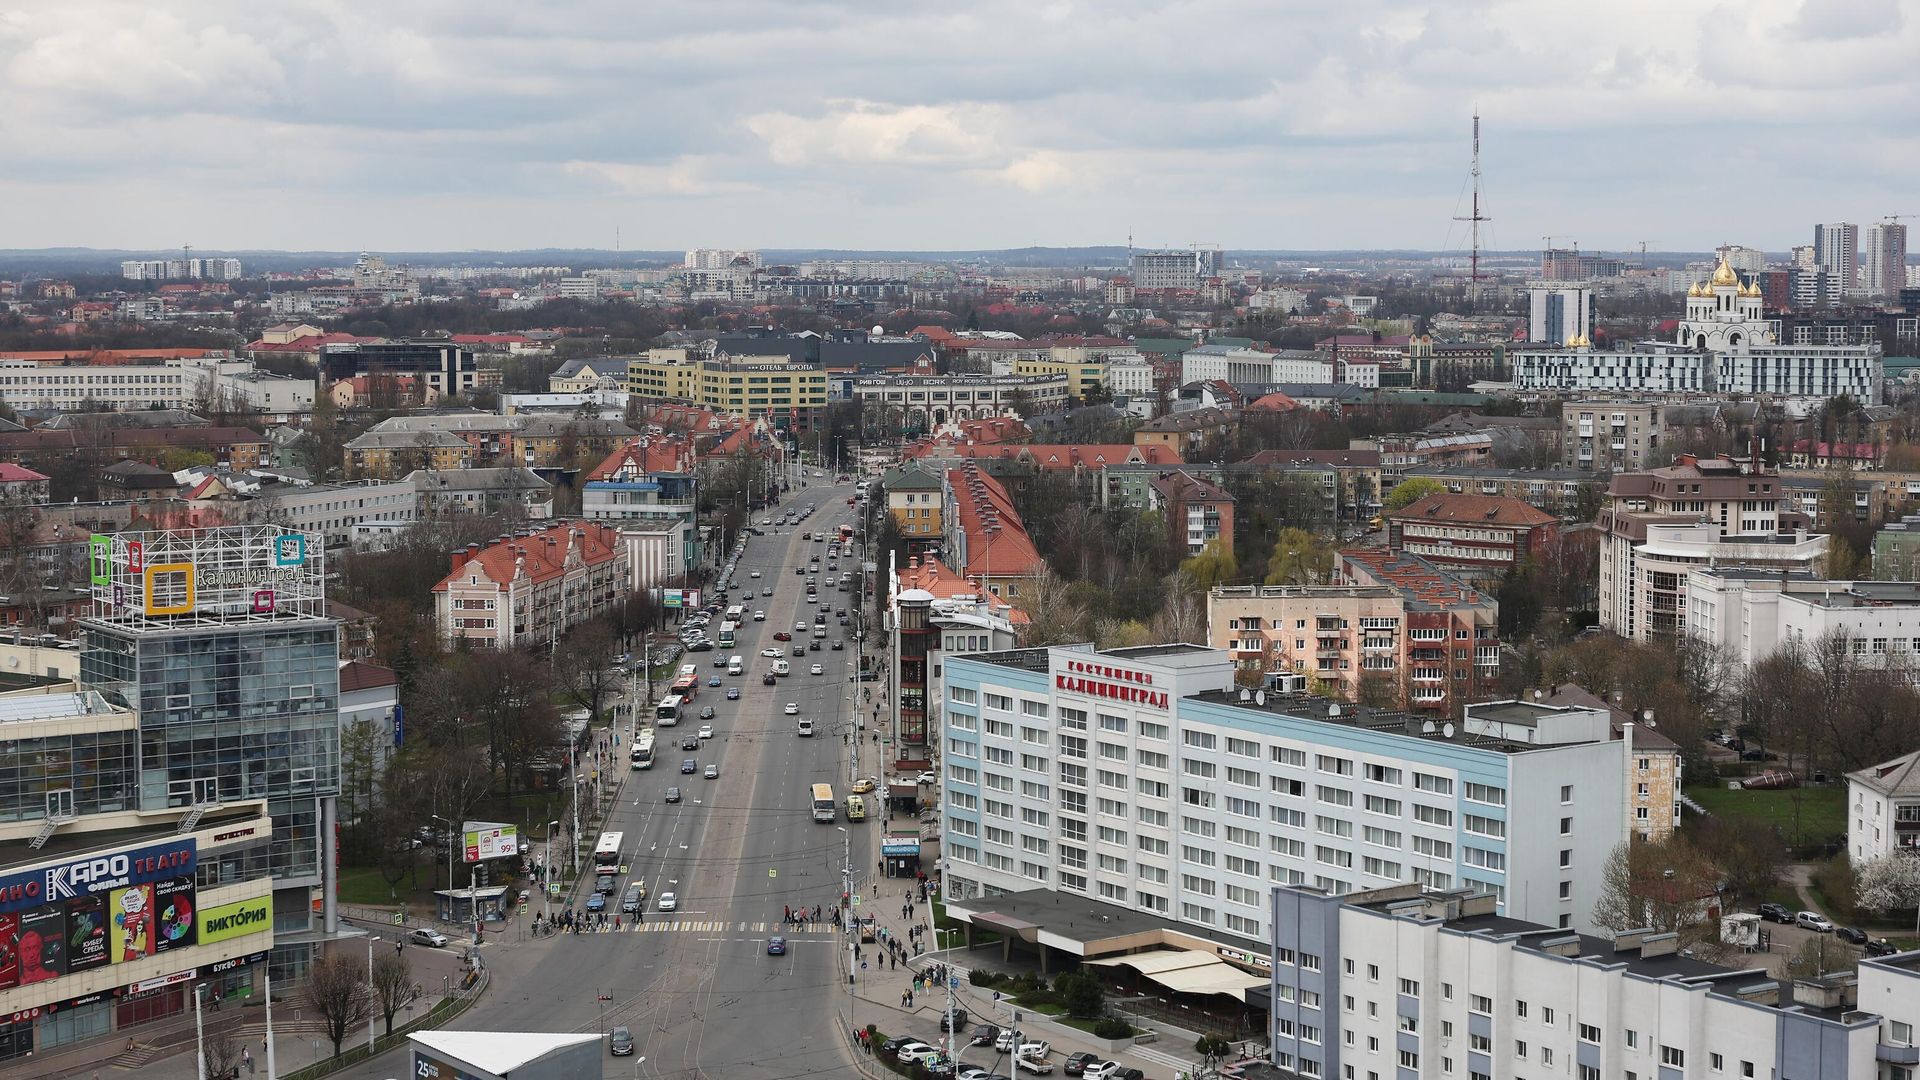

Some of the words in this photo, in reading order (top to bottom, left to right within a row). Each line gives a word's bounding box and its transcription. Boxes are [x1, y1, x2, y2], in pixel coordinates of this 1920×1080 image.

[196, 567, 306, 586] Калининград
[1068, 660, 1153, 684] ГОСТИНИЦА
[1056, 675, 1169, 710] КАЛИНИНГРАД
[135, 850, 191, 875] ТЕАТР
[46, 854, 129, 901] КАРО
[157, 881, 175, 889] Найди
[417, 1060, 429, 1078] 25
